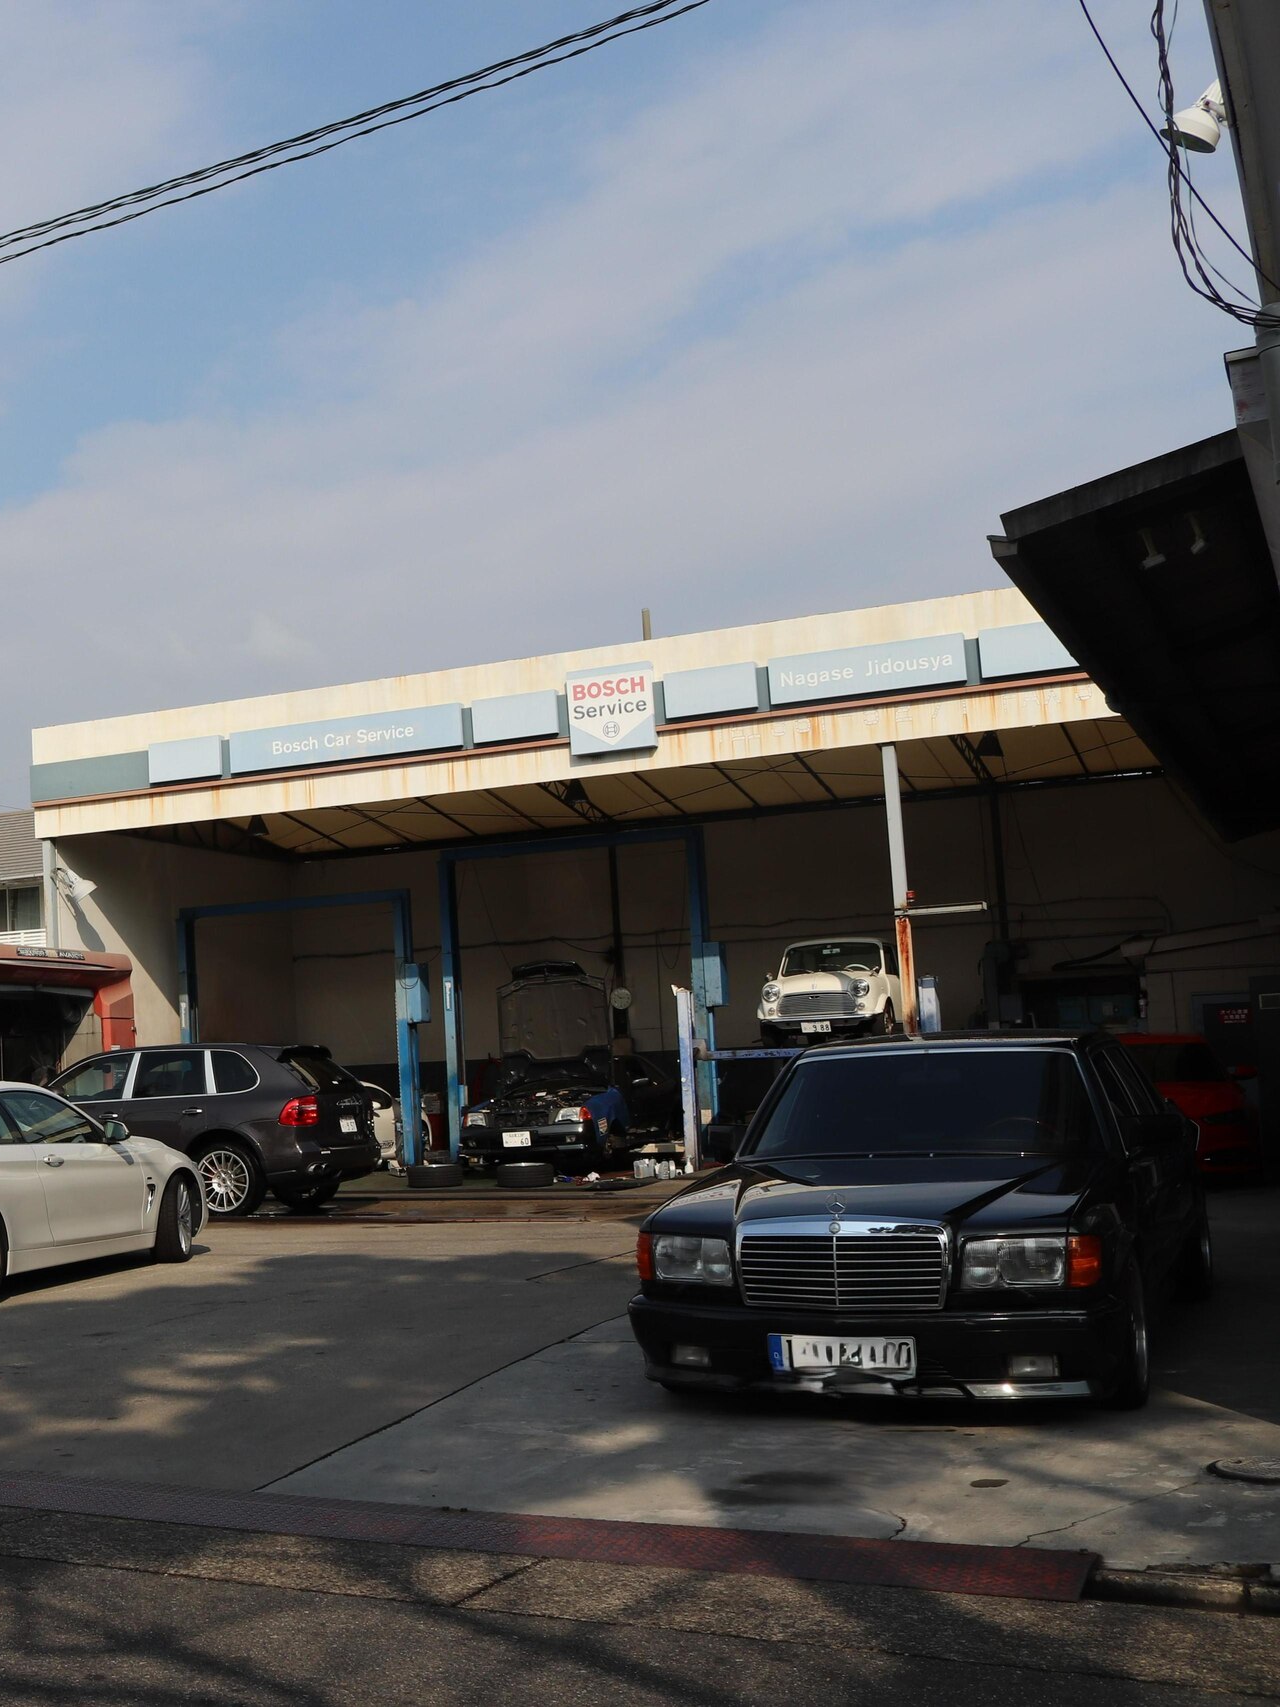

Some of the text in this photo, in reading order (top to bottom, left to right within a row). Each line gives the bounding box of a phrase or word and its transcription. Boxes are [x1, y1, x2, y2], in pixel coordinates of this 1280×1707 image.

[780, 654, 952, 687] Nagase Jidousya
[572, 675, 645, 702] BOSCH
[573, 699, 647, 720] Service
[272, 725, 414, 755] Bosch Car Service
